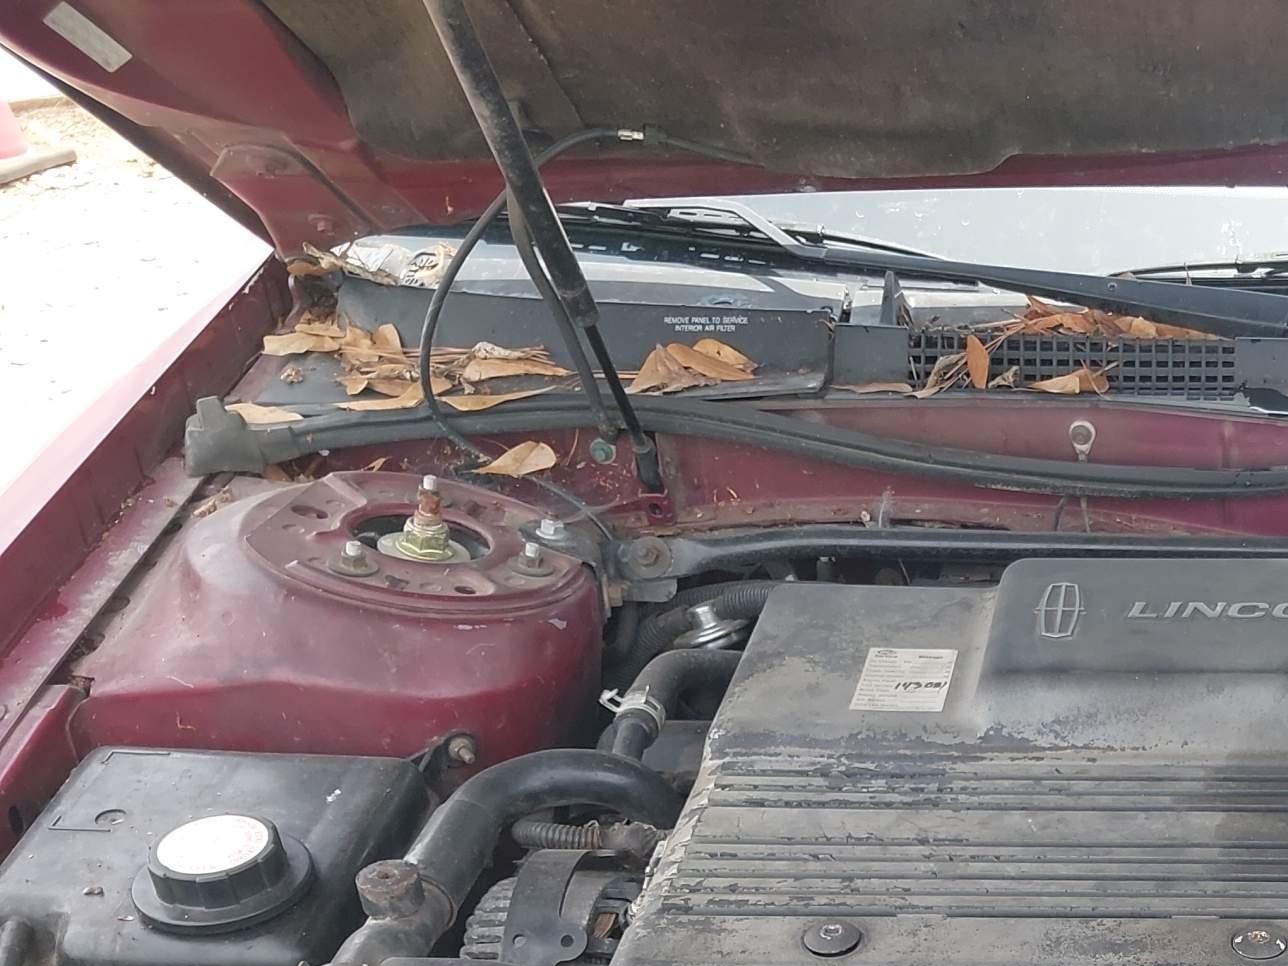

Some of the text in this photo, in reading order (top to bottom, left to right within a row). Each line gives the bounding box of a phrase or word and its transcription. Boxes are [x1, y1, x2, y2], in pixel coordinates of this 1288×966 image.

[663, 316, 690, 325] REMOVE
[691, 316, 710, 325] PANEL
[722, 315, 749, 325] SERVICE
[716, 325, 736, 333] FILTER
